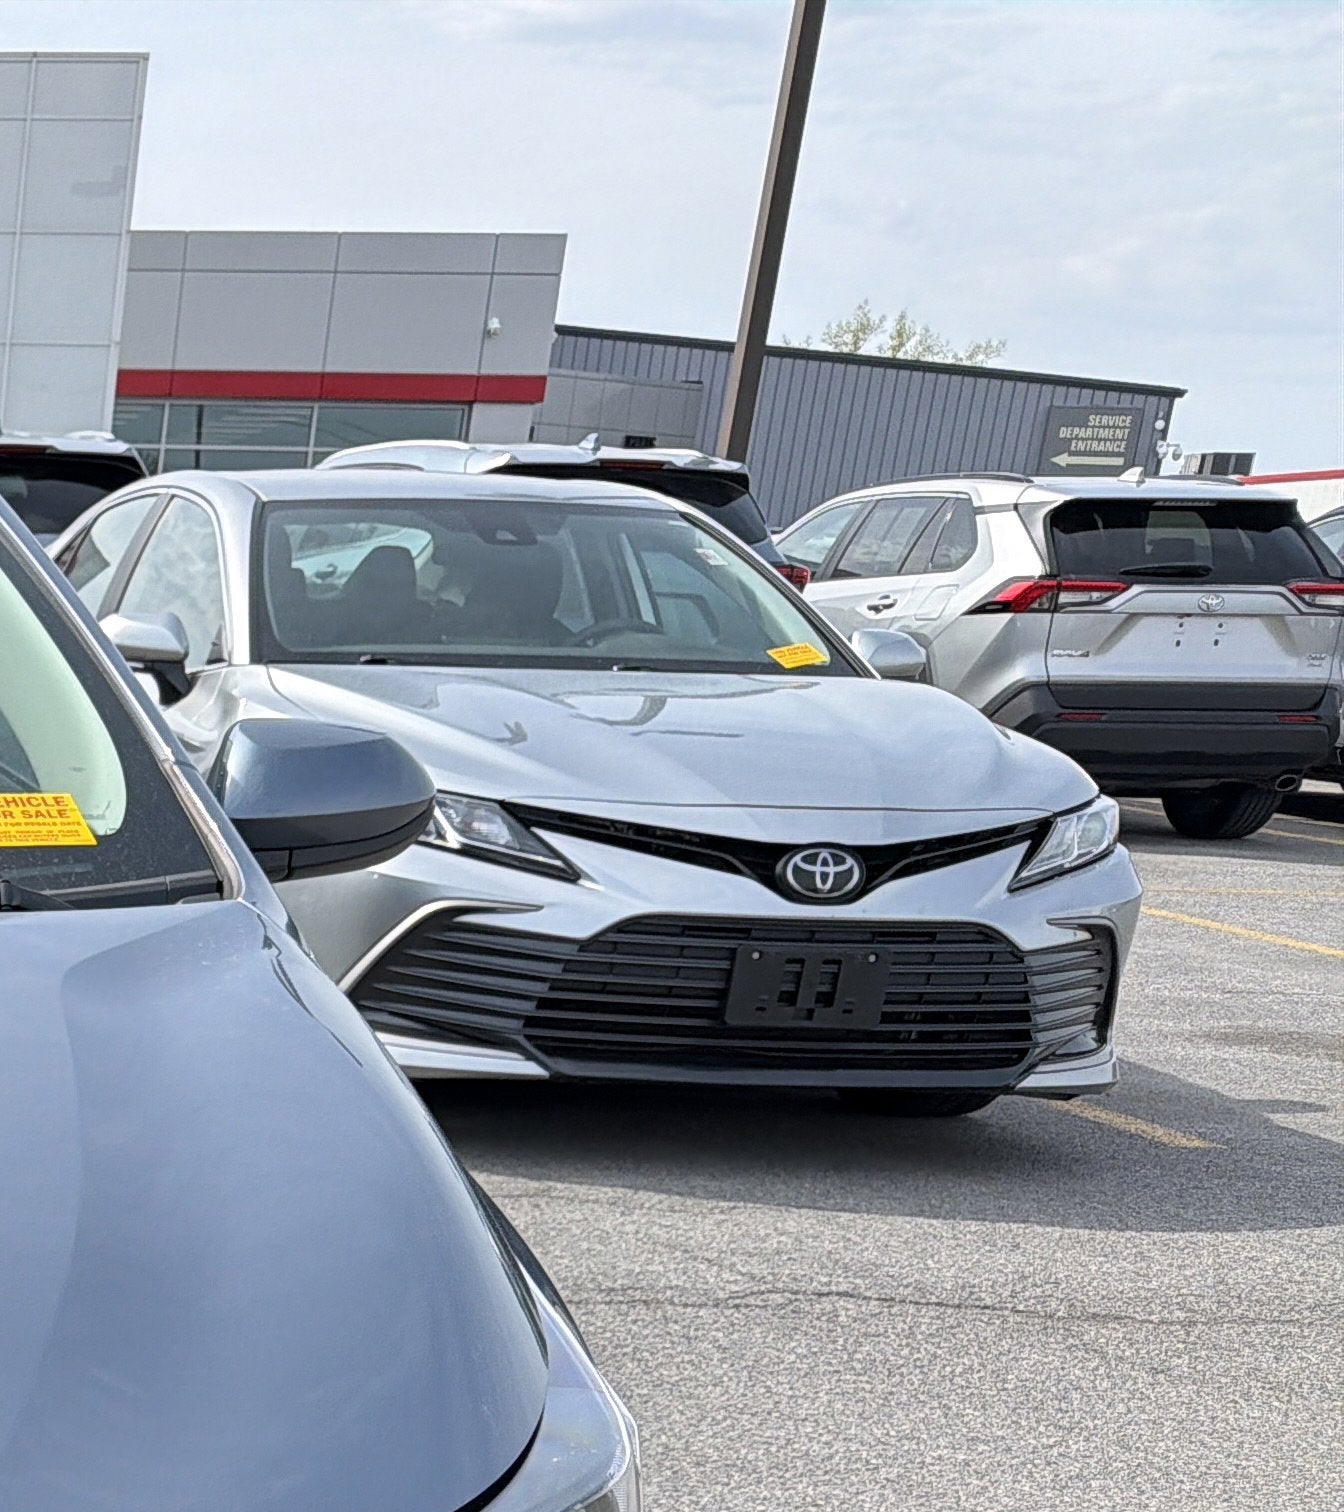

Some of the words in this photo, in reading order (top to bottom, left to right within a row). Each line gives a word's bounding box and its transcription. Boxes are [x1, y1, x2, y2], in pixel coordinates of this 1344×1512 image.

[1087, 414, 1133, 427] SERVICE
[1058, 426, 1131, 440] DEPARTMENT
[1070, 439, 1128, 453] ENTRANCE
[20, 808, 71, 819] SALE
